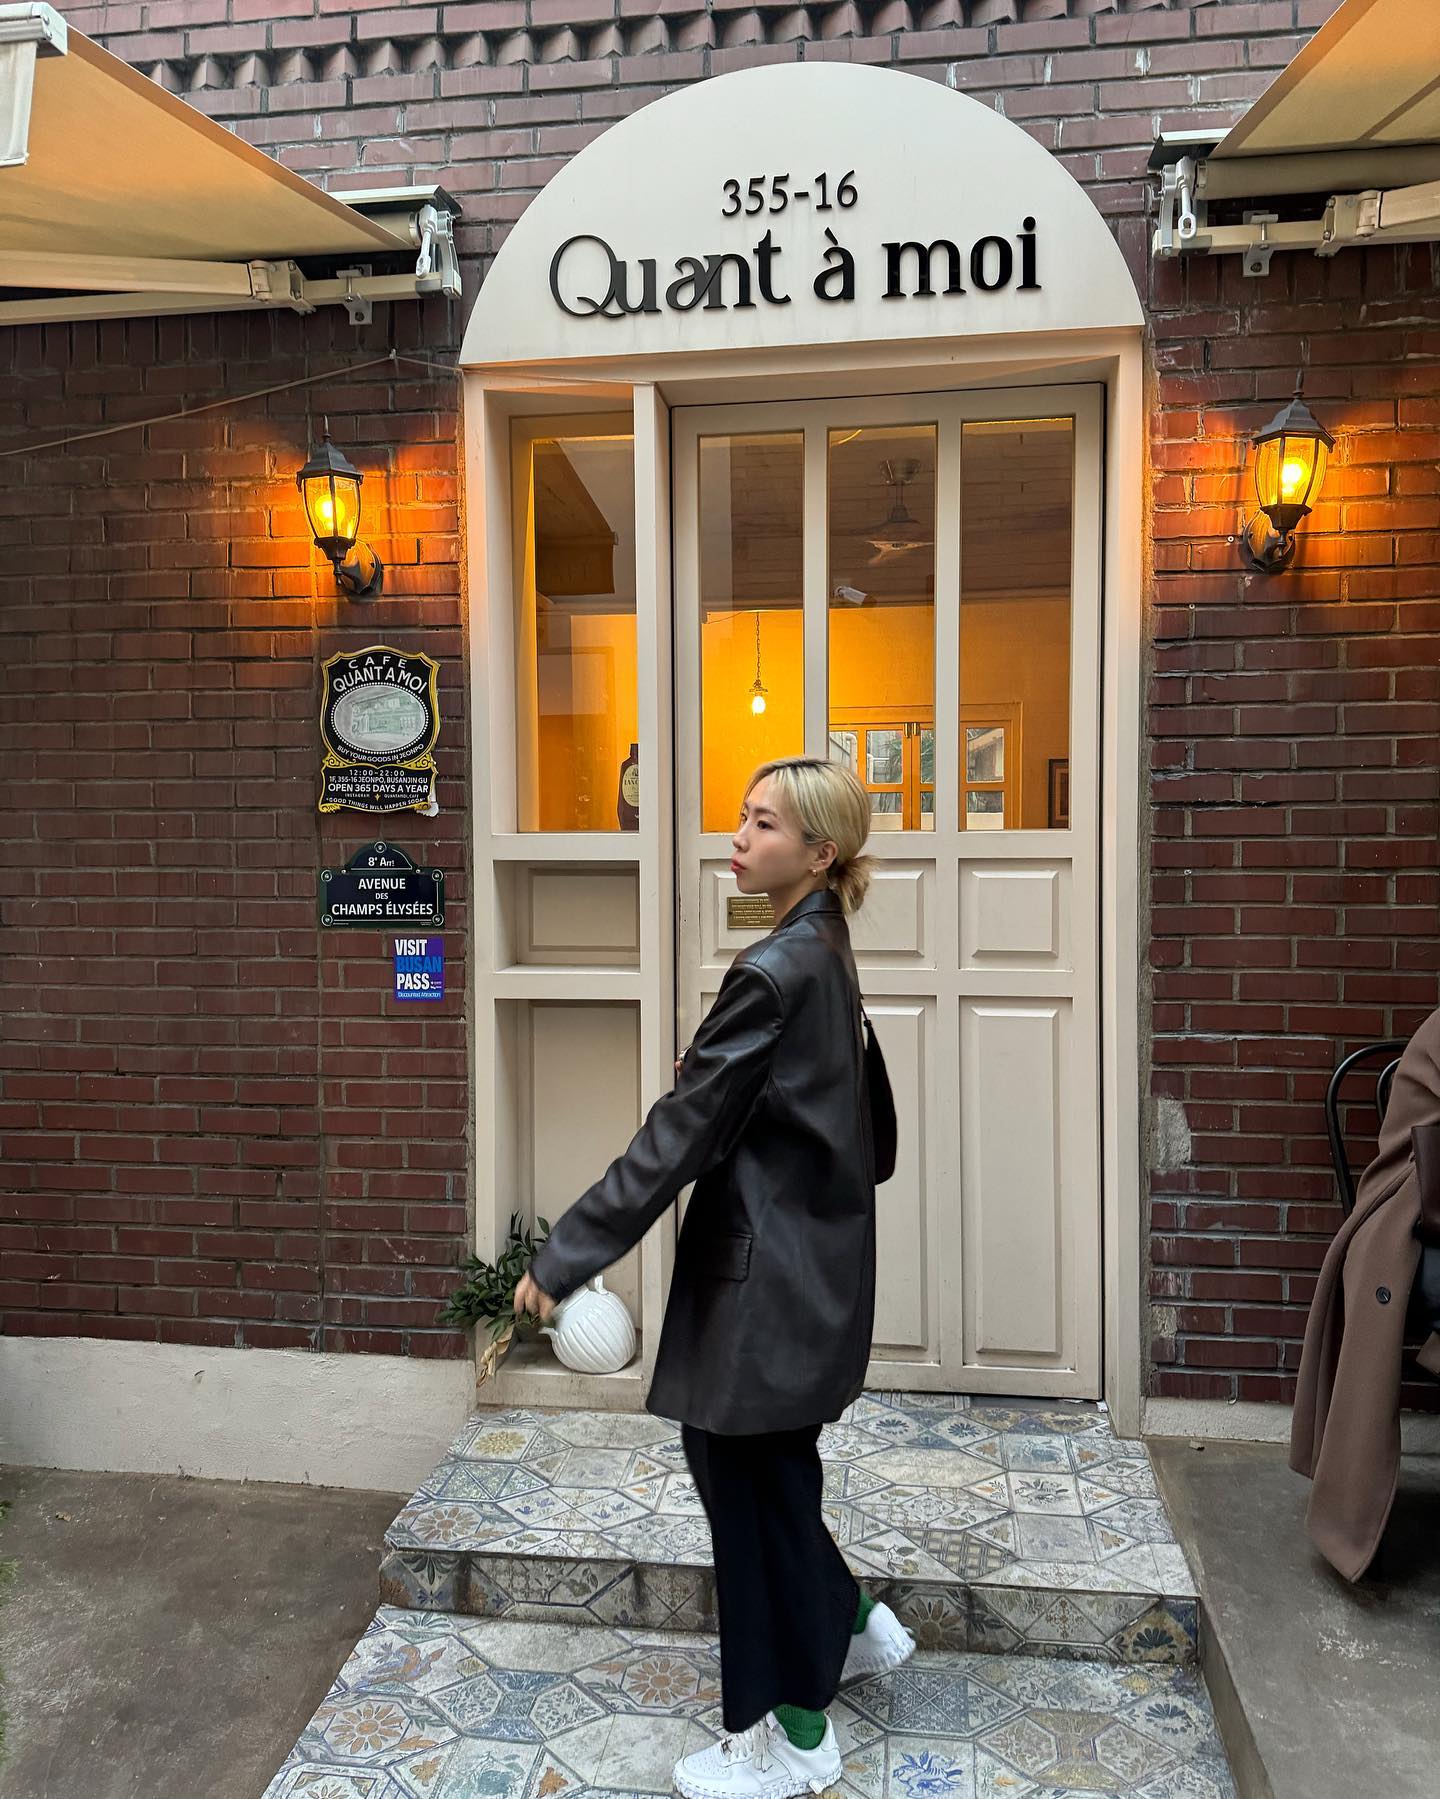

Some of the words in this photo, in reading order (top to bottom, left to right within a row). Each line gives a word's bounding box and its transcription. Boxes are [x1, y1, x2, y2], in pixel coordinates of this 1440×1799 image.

[722, 170, 858, 217] 355-16
[549, 229, 791, 318] Quant
[814, 227, 856, 301] à
[880, 216, 1042, 299] moi
[348, 656, 408, 669] CAFE
[333, 666, 383, 692] QUANT
[385, 667, 395, 682] A
[397, 670, 428, 694] MOI
[337, 745, 349, 755] BUY
[350, 751, 367, 761] YOUR
[399, 744, 424, 759] JEONPO
[328, 783, 353, 792] OPEN
[354, 784, 371, 792] 365
[372, 784, 396, 793] DAYS
[397, 784, 404, 793] A
[405, 784, 429, 793] YEAR
[348, 799, 368, 809] THINGS
[384, 801, 407, 810] HAPPEN
[358, 878, 406, 890] AVENUE
[375, 892, 389, 900] DES
[331, 903, 383, 915] CHAMPS
[386, 901, 433, 915] ÉLYSÉES
[395, 939, 428, 956] VISIT
[396, 956, 442, 973] BUSAN
[396, 973, 430, 990] PASS
